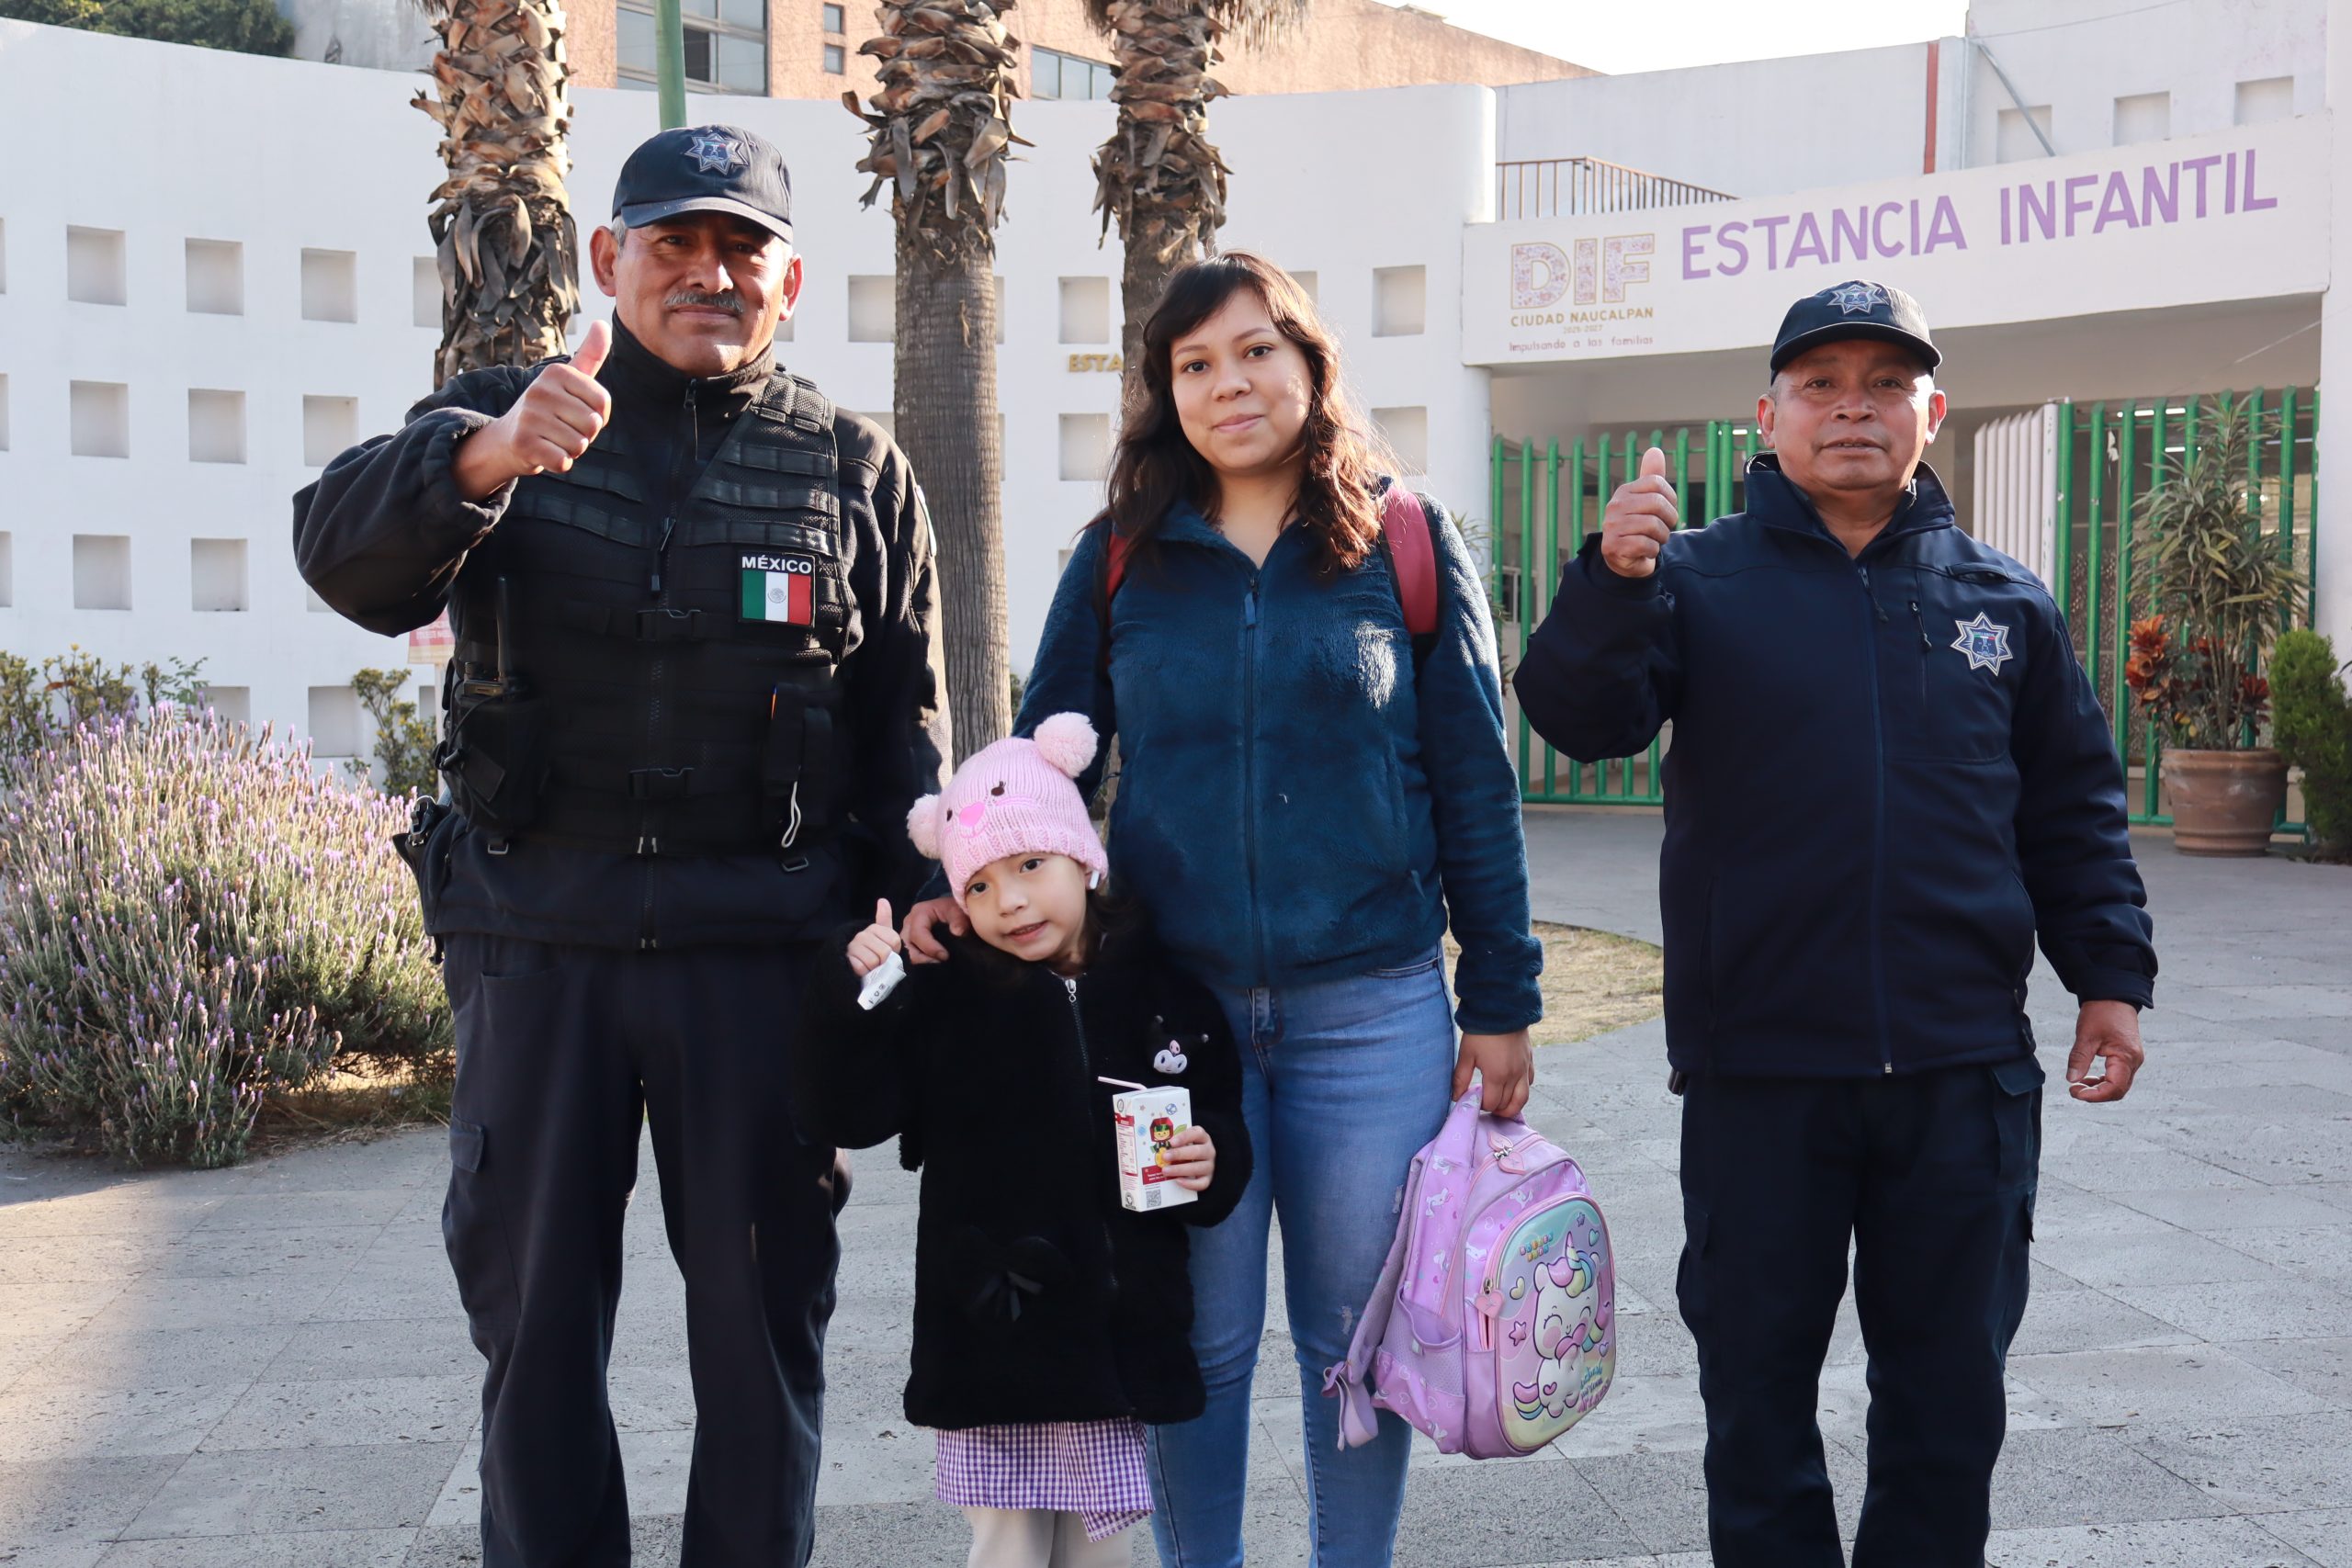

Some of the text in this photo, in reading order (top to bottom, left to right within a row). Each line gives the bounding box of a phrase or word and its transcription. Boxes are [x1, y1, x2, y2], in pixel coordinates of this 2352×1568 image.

[1681, 147, 2278, 280] ESTANCIA INFANTIL
[1510, 232, 1656, 310] DIF
[1510, 307, 1654, 327] CIUDAD NAUCALPAN
[1509, 334, 1654, 353] Impulsando a las familias
[741, 554, 812, 574] MÉXICO
